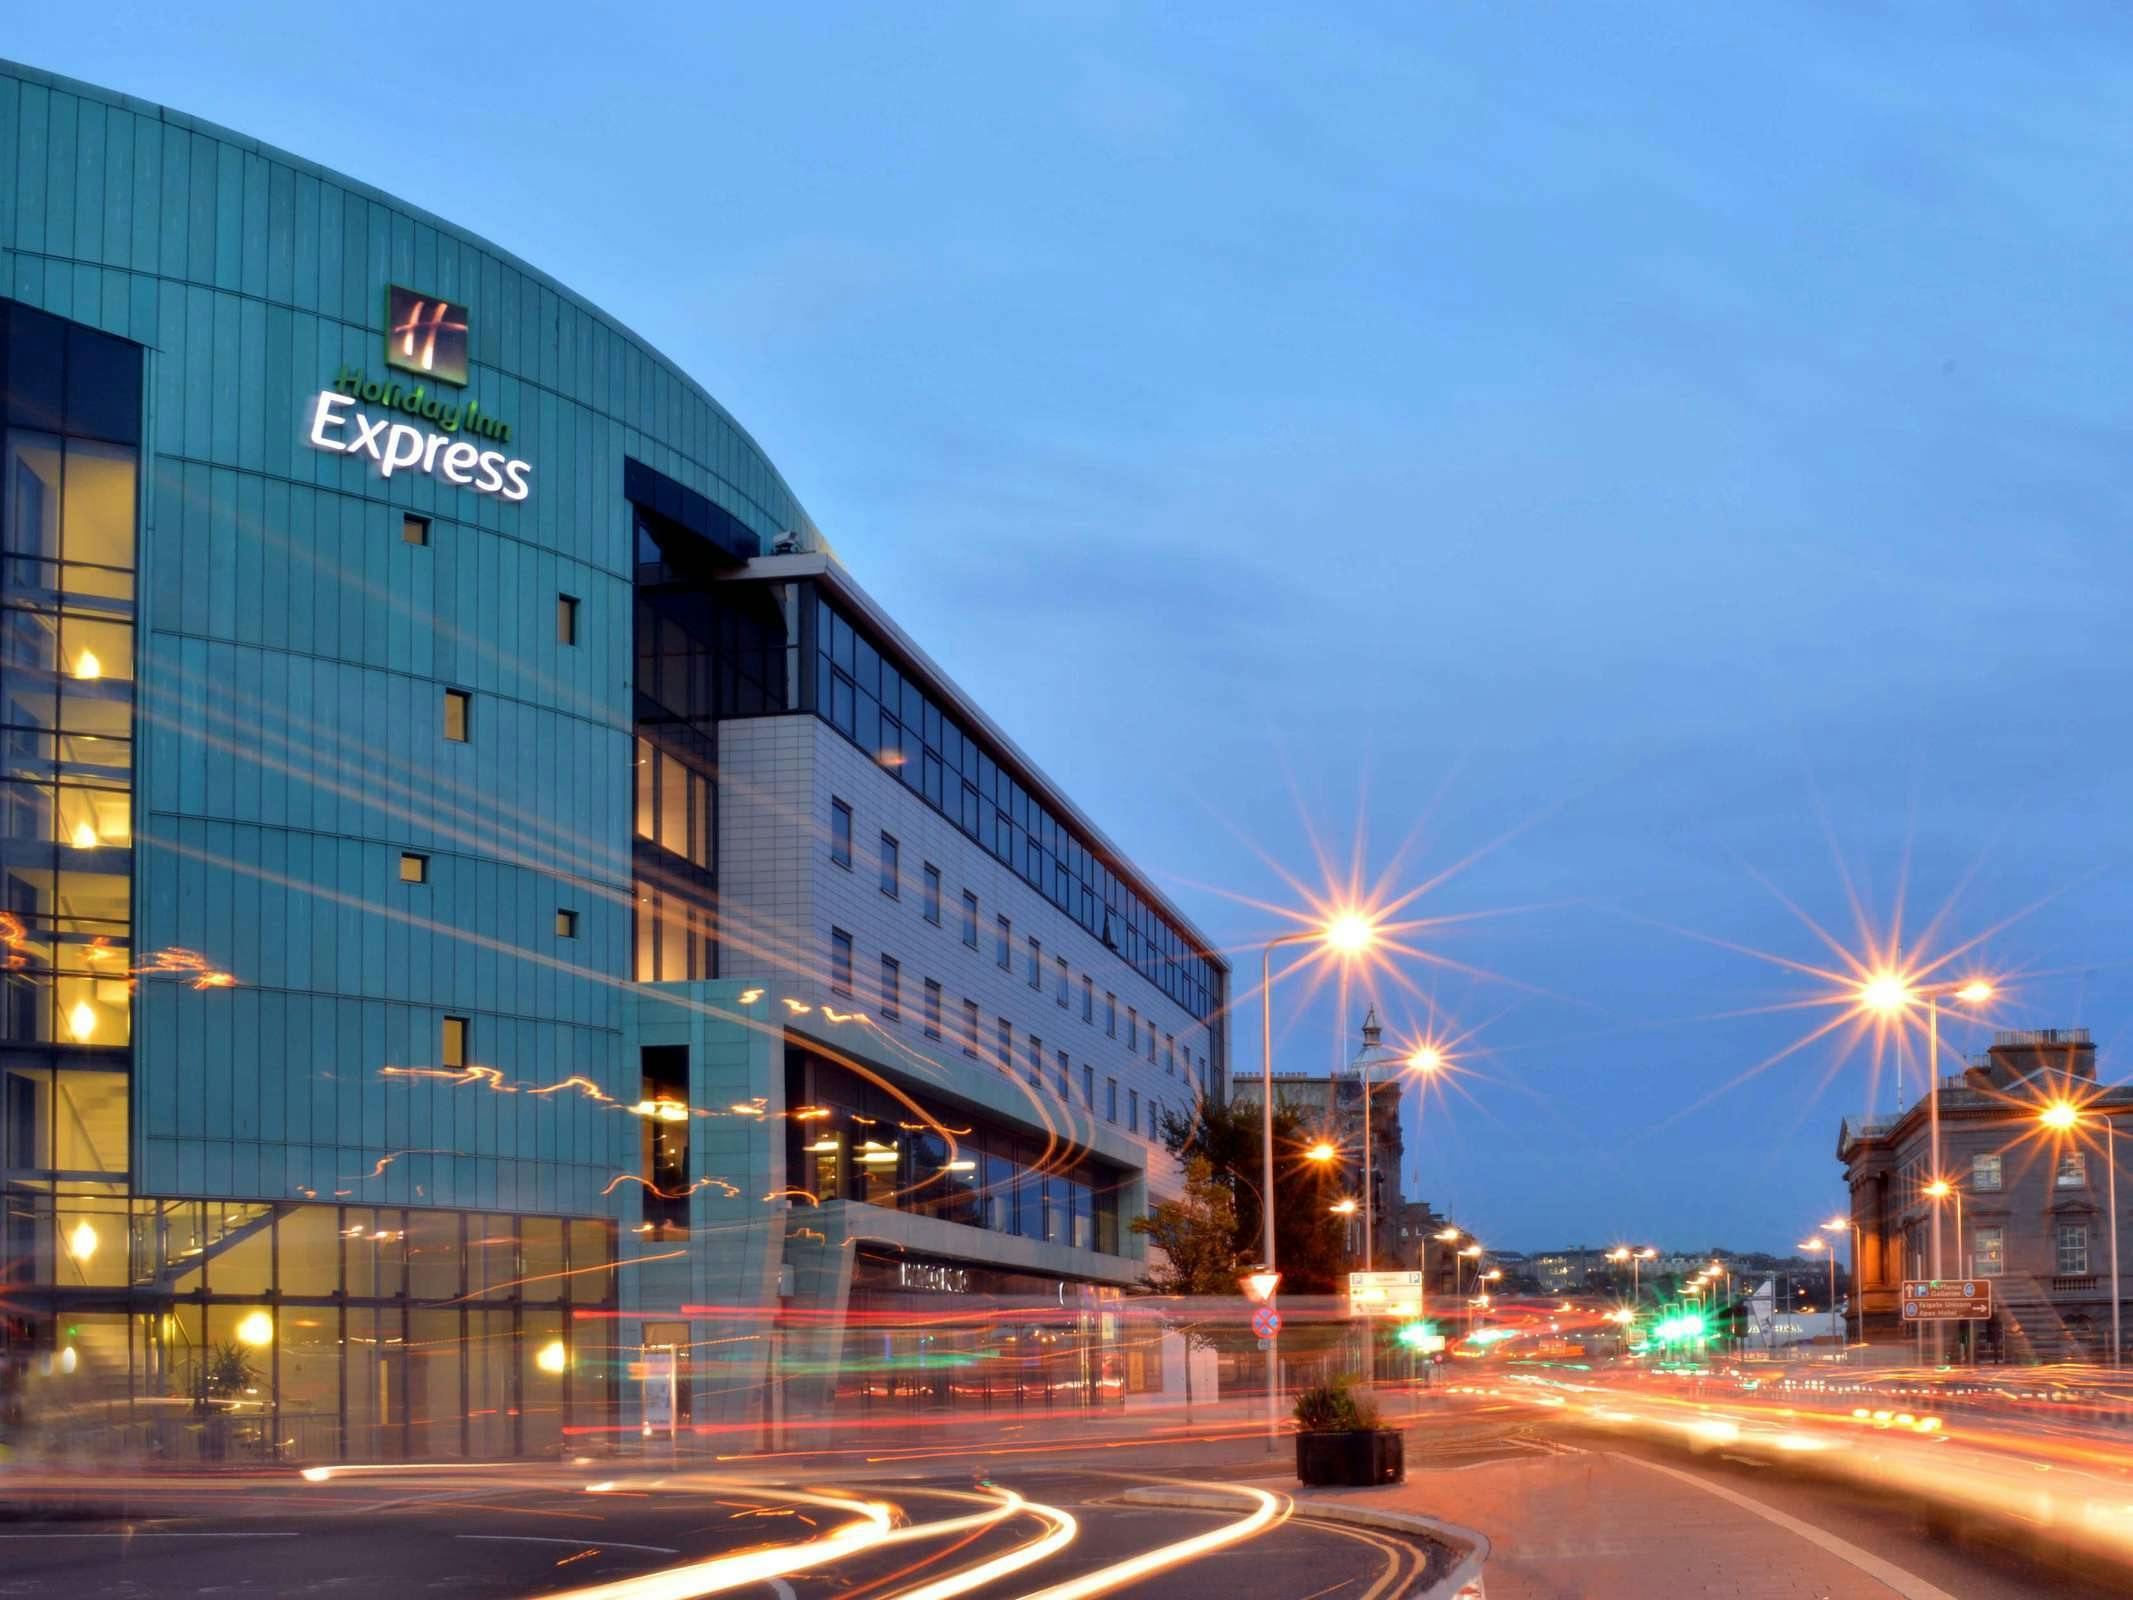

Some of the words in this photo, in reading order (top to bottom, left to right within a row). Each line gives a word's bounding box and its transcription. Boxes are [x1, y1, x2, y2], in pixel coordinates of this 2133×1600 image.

[310, 390, 533, 500] Express
[333, 365, 461, 432] Holiday
[463, 400, 513, 442] Inn
